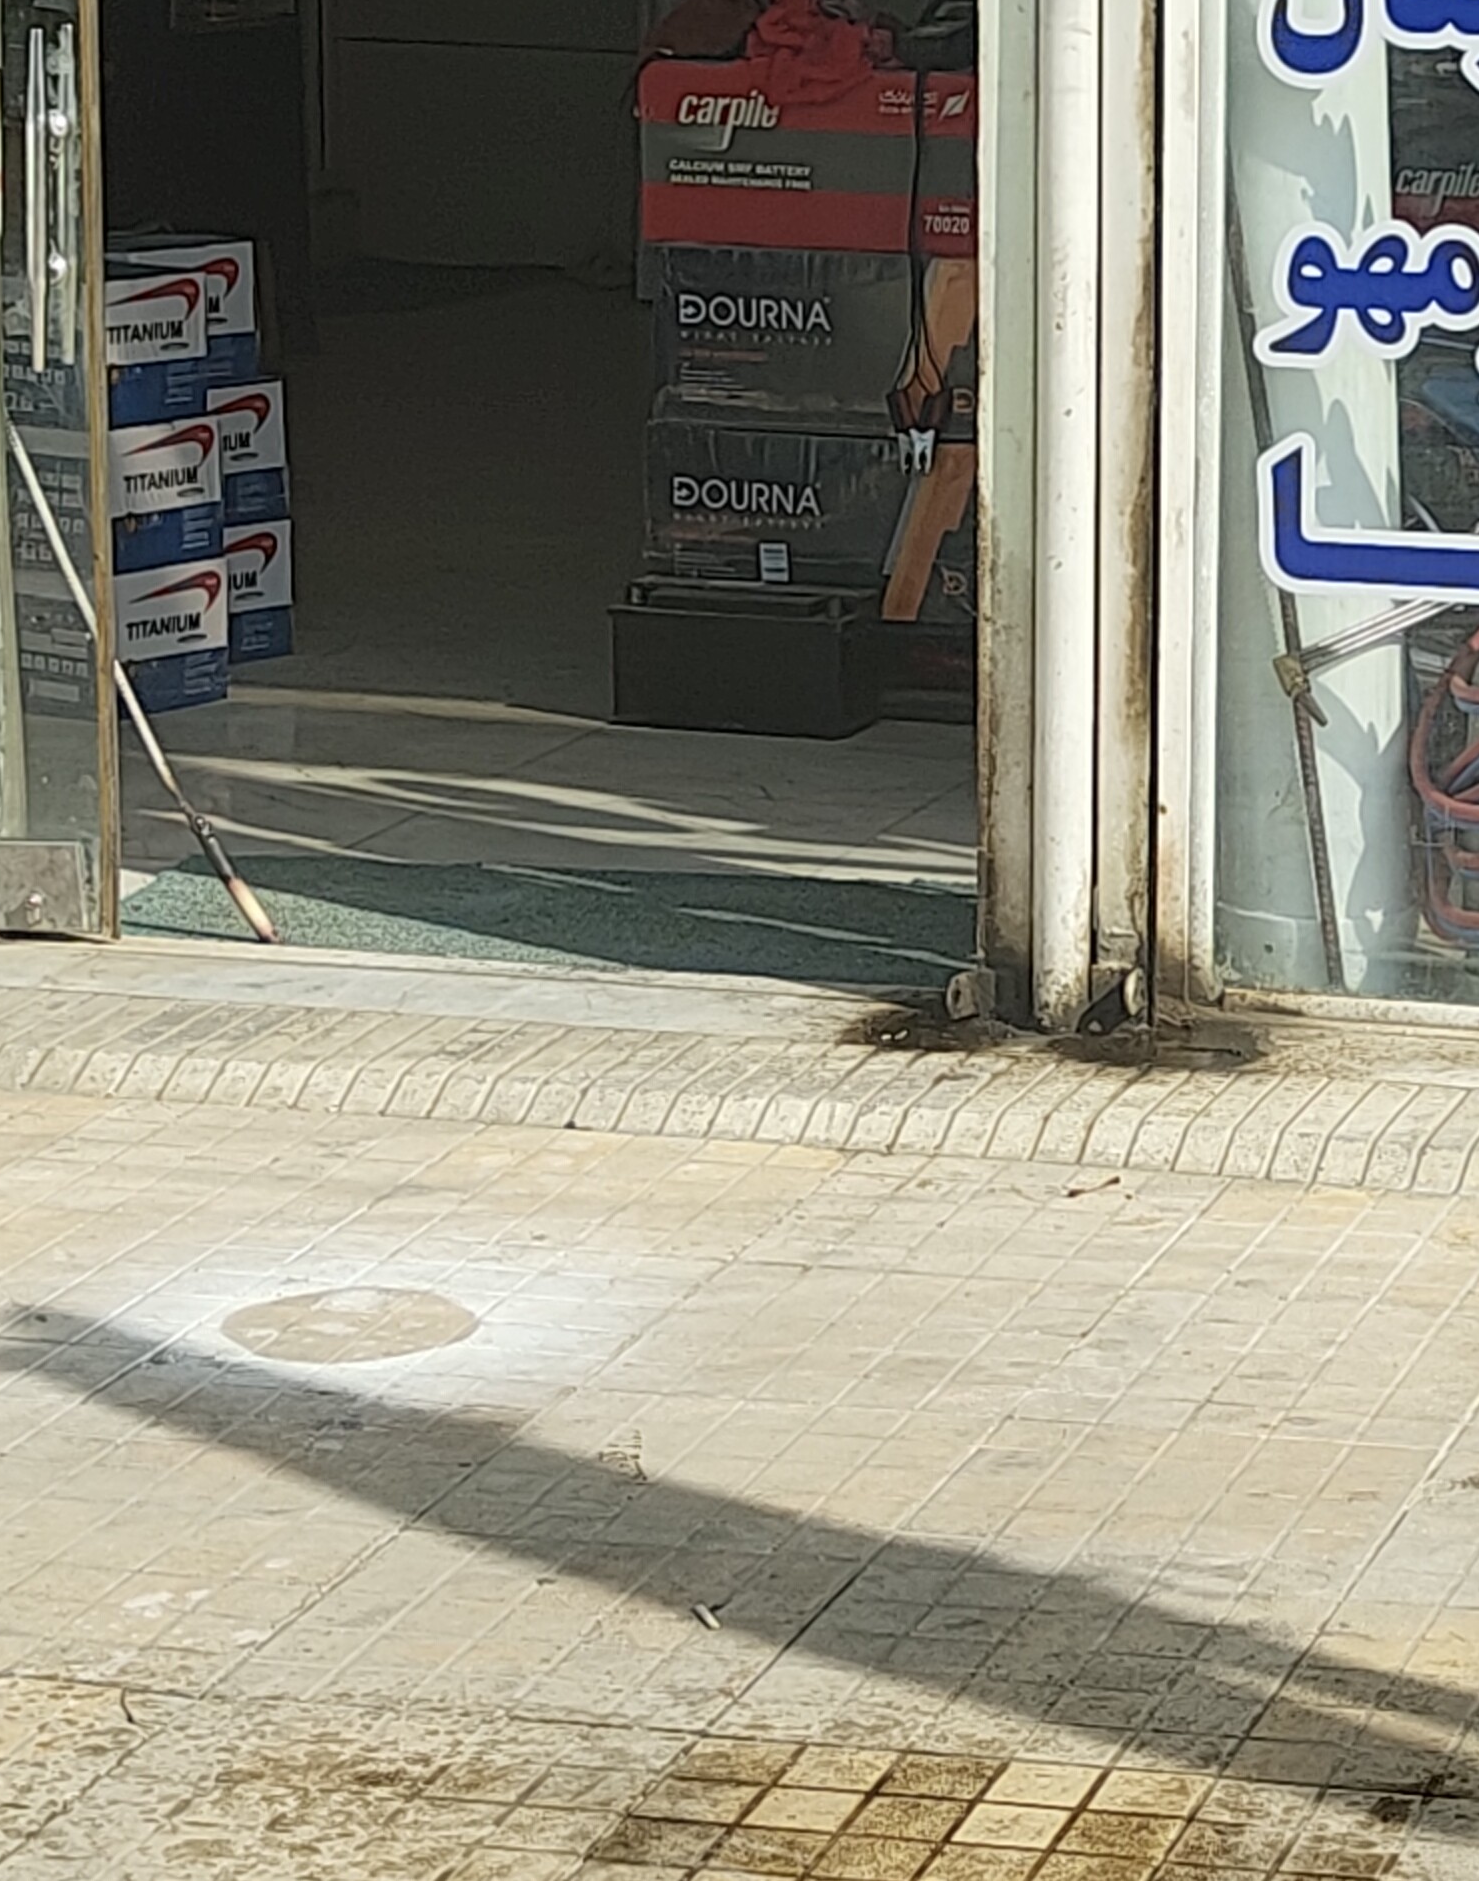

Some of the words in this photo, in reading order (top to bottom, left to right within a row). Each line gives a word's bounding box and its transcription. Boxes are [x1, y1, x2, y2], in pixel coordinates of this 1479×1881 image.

[923, 215, 970, 234] 70020
[678, 293, 832, 332] DOURNA
[106, 320, 184, 345] TITANIUM
[124, 464, 199, 494] TITANIUM
[671, 475, 821, 517] DOURNA
[126, 612, 201, 641] TITANIUM
